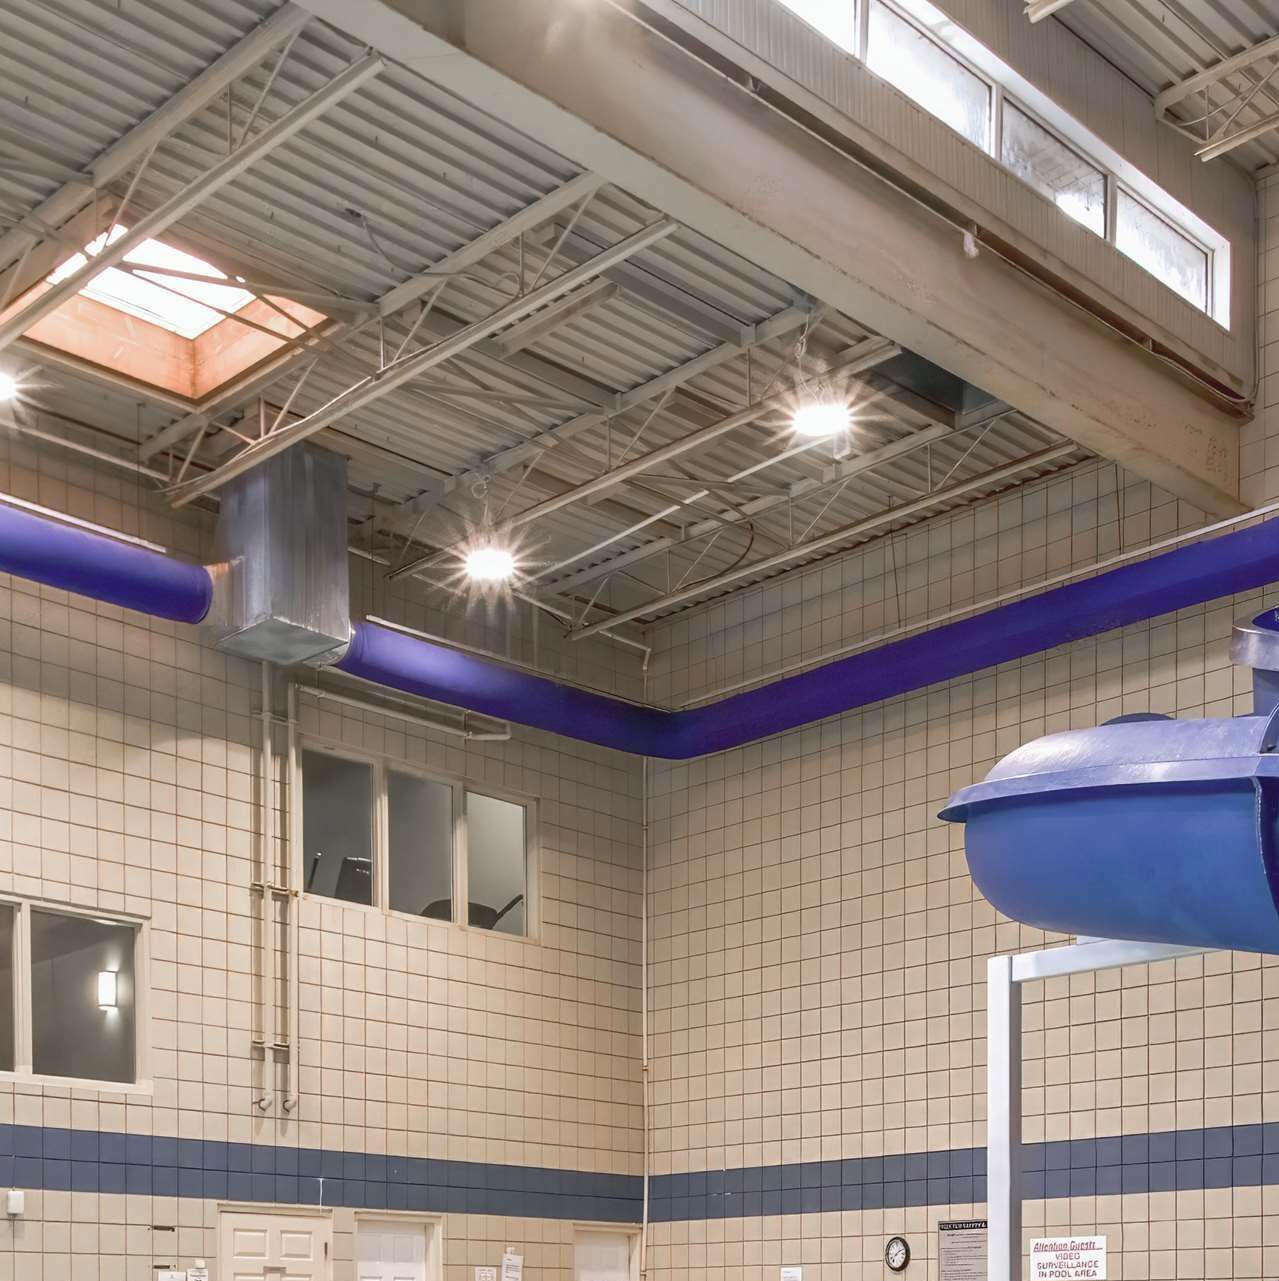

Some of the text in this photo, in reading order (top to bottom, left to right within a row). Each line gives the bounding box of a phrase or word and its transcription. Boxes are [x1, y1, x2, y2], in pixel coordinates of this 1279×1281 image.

[1037, 1260, 1099, 1270] SURVEILLANCE
[1049, 1270, 1072, 1278] POOL
[1075, 1269, 1097, 1277] AREA
